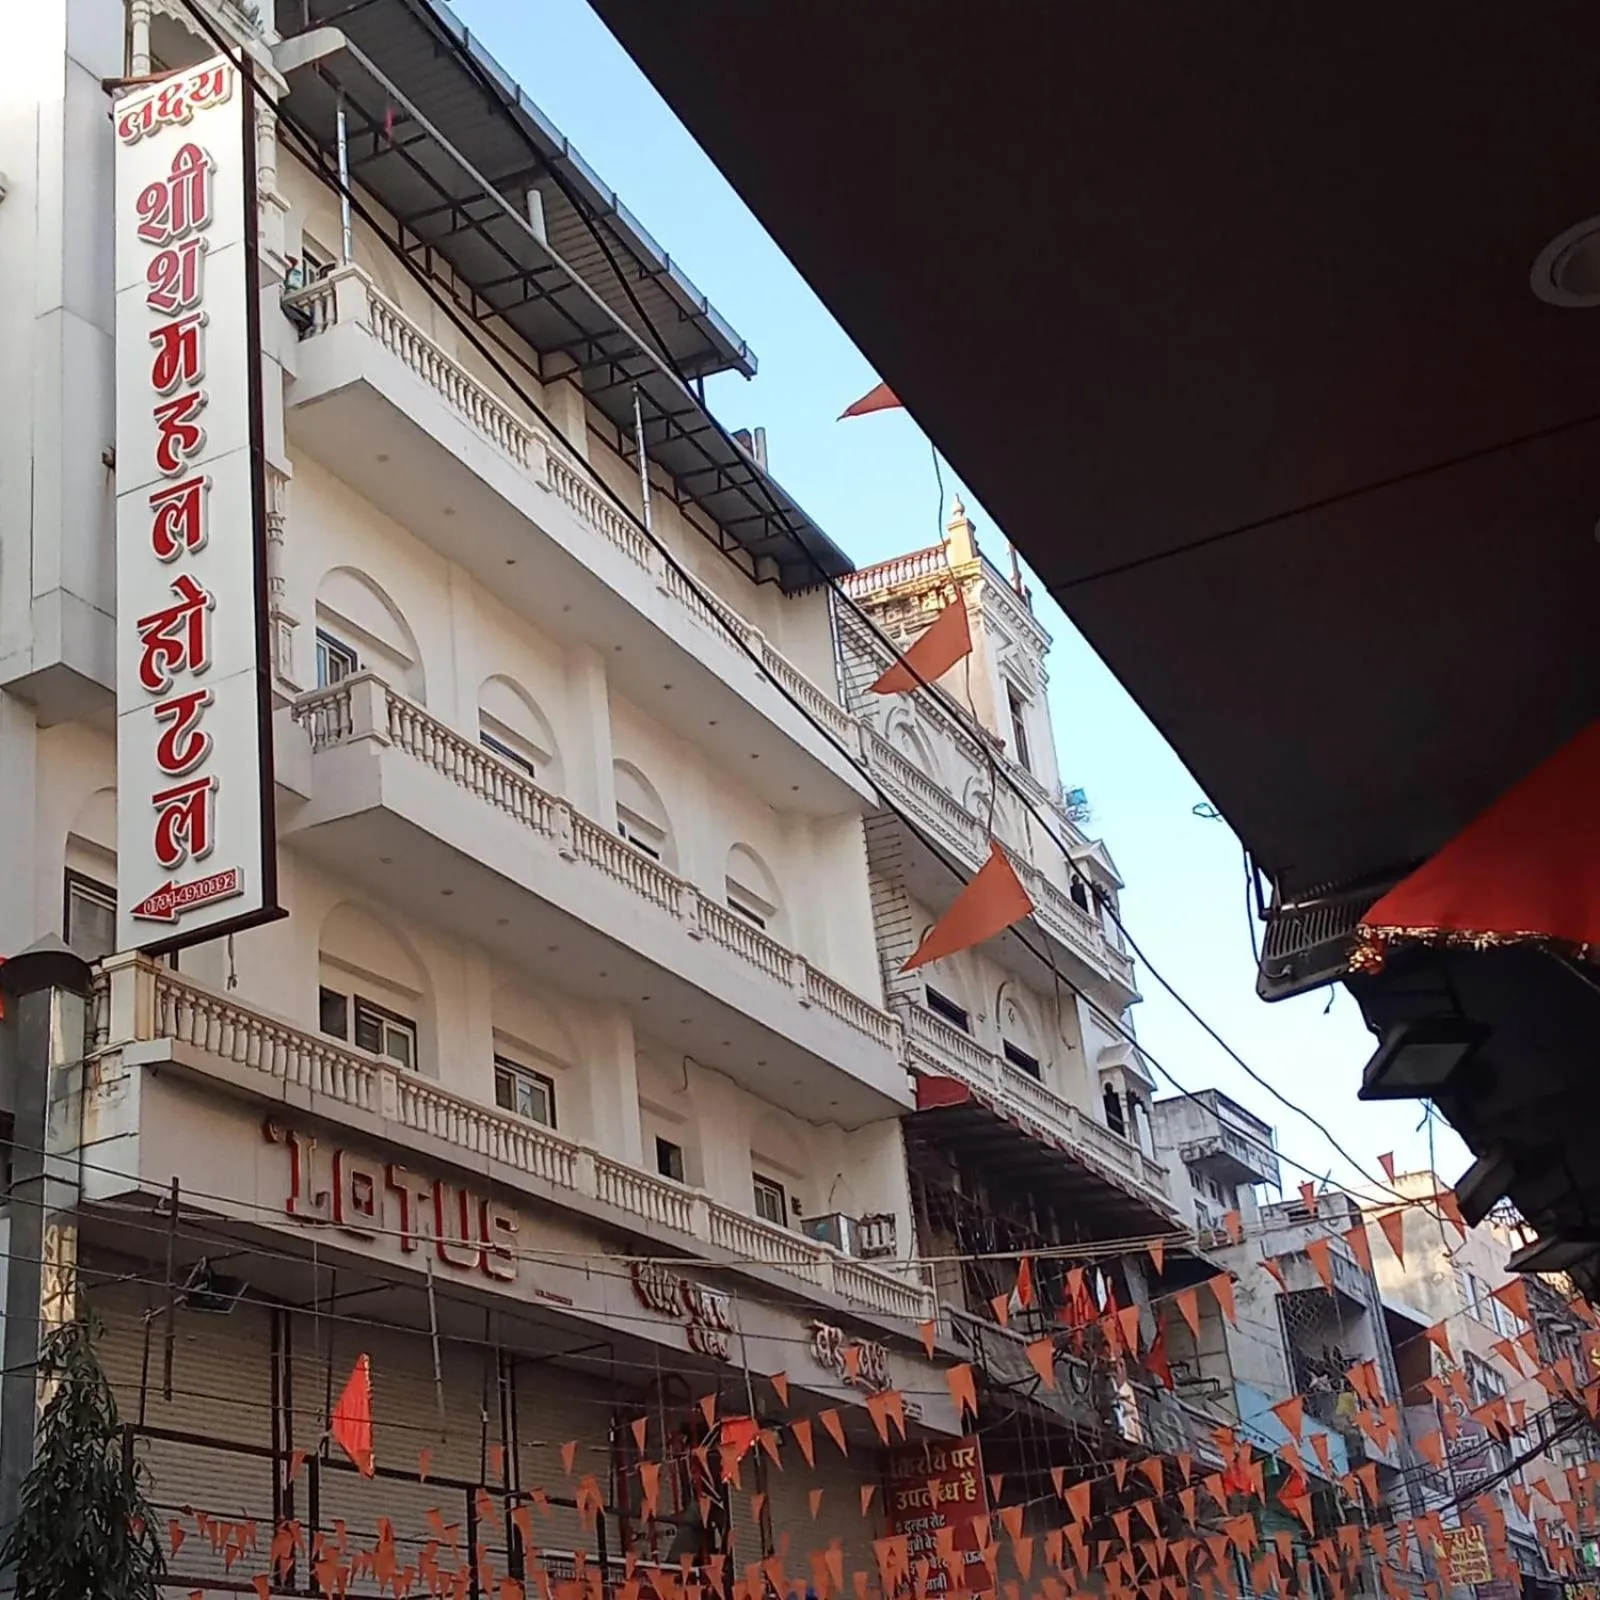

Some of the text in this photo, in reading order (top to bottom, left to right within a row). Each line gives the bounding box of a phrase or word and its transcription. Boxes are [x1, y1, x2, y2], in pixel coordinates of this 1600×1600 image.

[136, 573, 219, 869] होटल
[143, 872, 235, 915] 0731-4910392
[264, 1117, 520, 1281] LOTUS
[950, 1446, 976, 1469] पर
[961, 1471, 977, 1501] है
